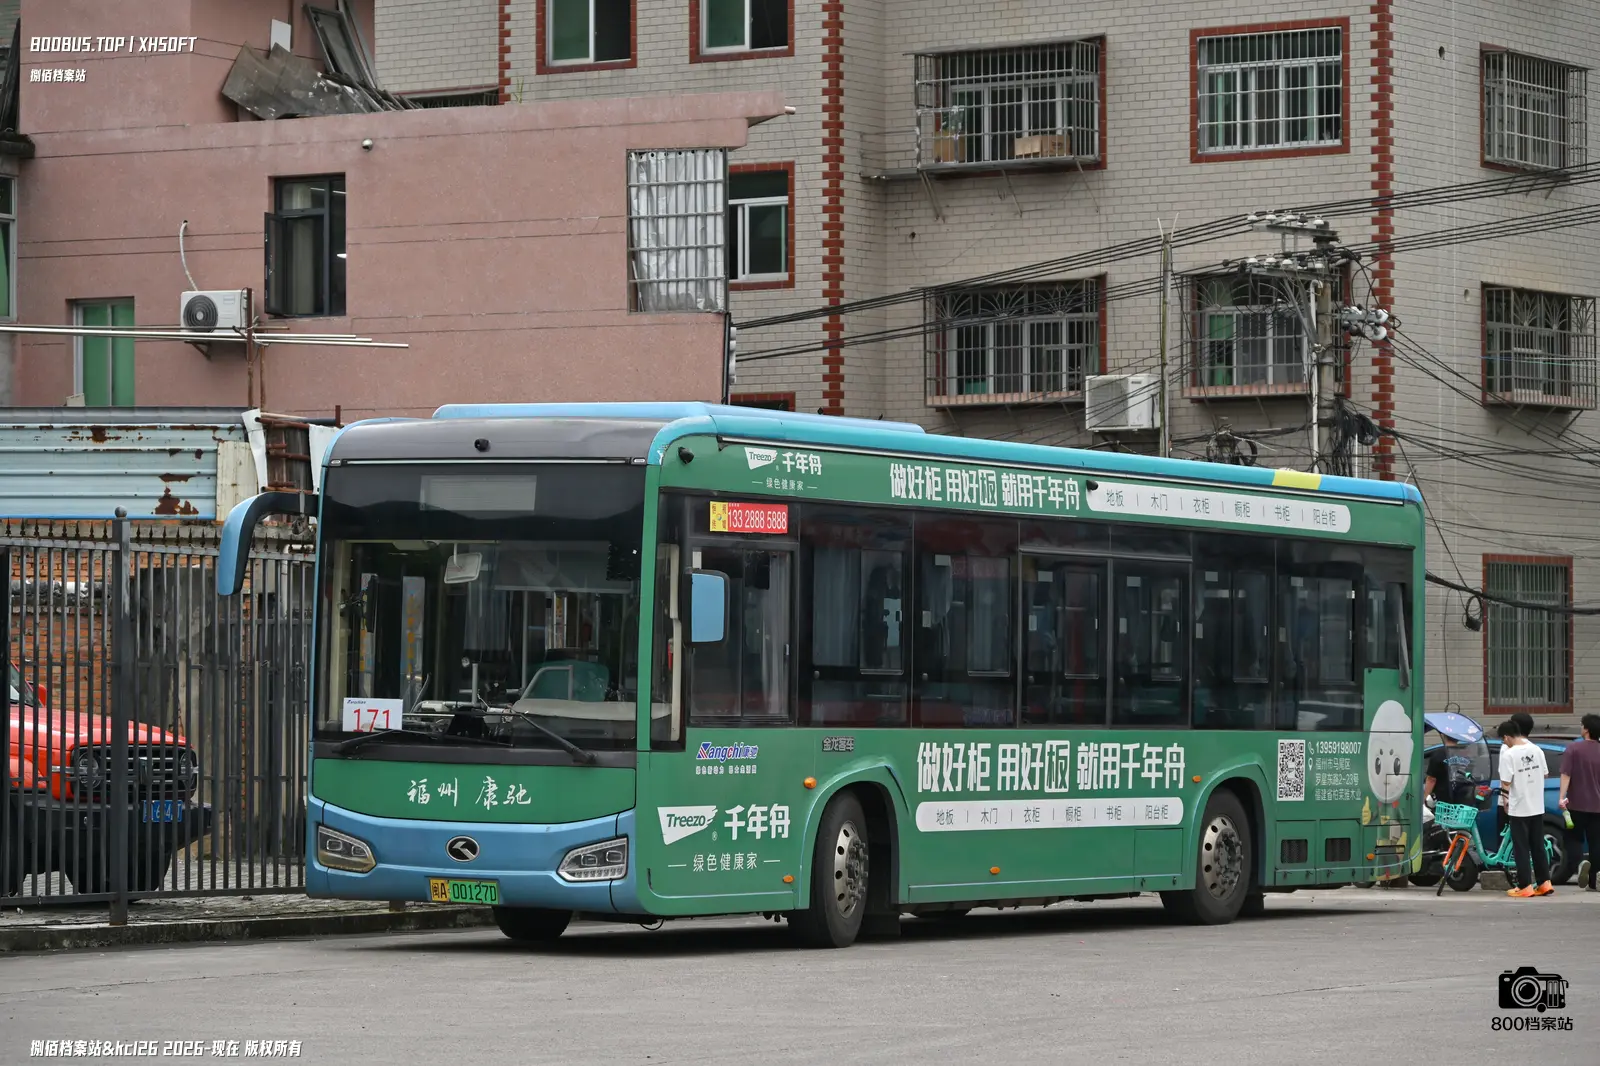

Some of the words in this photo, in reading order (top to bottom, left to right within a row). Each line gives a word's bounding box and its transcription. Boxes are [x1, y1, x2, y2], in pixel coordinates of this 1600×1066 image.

[782, 451, 823, 476] 千年舟
[765, 476, 805, 492] 绿色健康家
[889, 462, 943, 503] 做好柜
[944, 467, 999, 508] 用好板
[1000, 472, 1081, 512] 就用千年舟
[727, 509, 743, 528] 133
[744, 510, 766, 529] 2888
[767, 511, 787, 530] 5888
[1105, 489, 1126, 508] 地板
[1150, 493, 1170, 512] 木门
[1192, 497, 1211, 515] 衣柜
[1234, 500, 1252, 519] 橱柜
[1274, 504, 1291, 523] 书柜
[1312, 508, 1337, 527] 阳台柜
[353, 708, 391, 733] 171
[822, 736, 855, 753] 金龙客车
[1316, 741, 1362, 755] 13959198007
[917, 741, 992, 793] 做好柜
[997, 739, 1071, 793] 用好板
[1076, 741, 1187, 790] 就用千年舟
[406, 777, 460, 808] 福州
[474, 775, 533, 811] 康驰
[666, 813, 707, 827] Treezo
[723, 803, 791, 842] 千年舟
[935, 808, 955, 826] 地板
[980, 807, 999, 825] 木门
[1023, 806, 1041, 824] 衣柜
[1065, 805, 1082, 823] 橱柜
[1106, 804, 1123, 822] 书柜
[1144, 803, 1169, 822] 阳台柜
[692, 851, 759, 873] 绿色健康家
